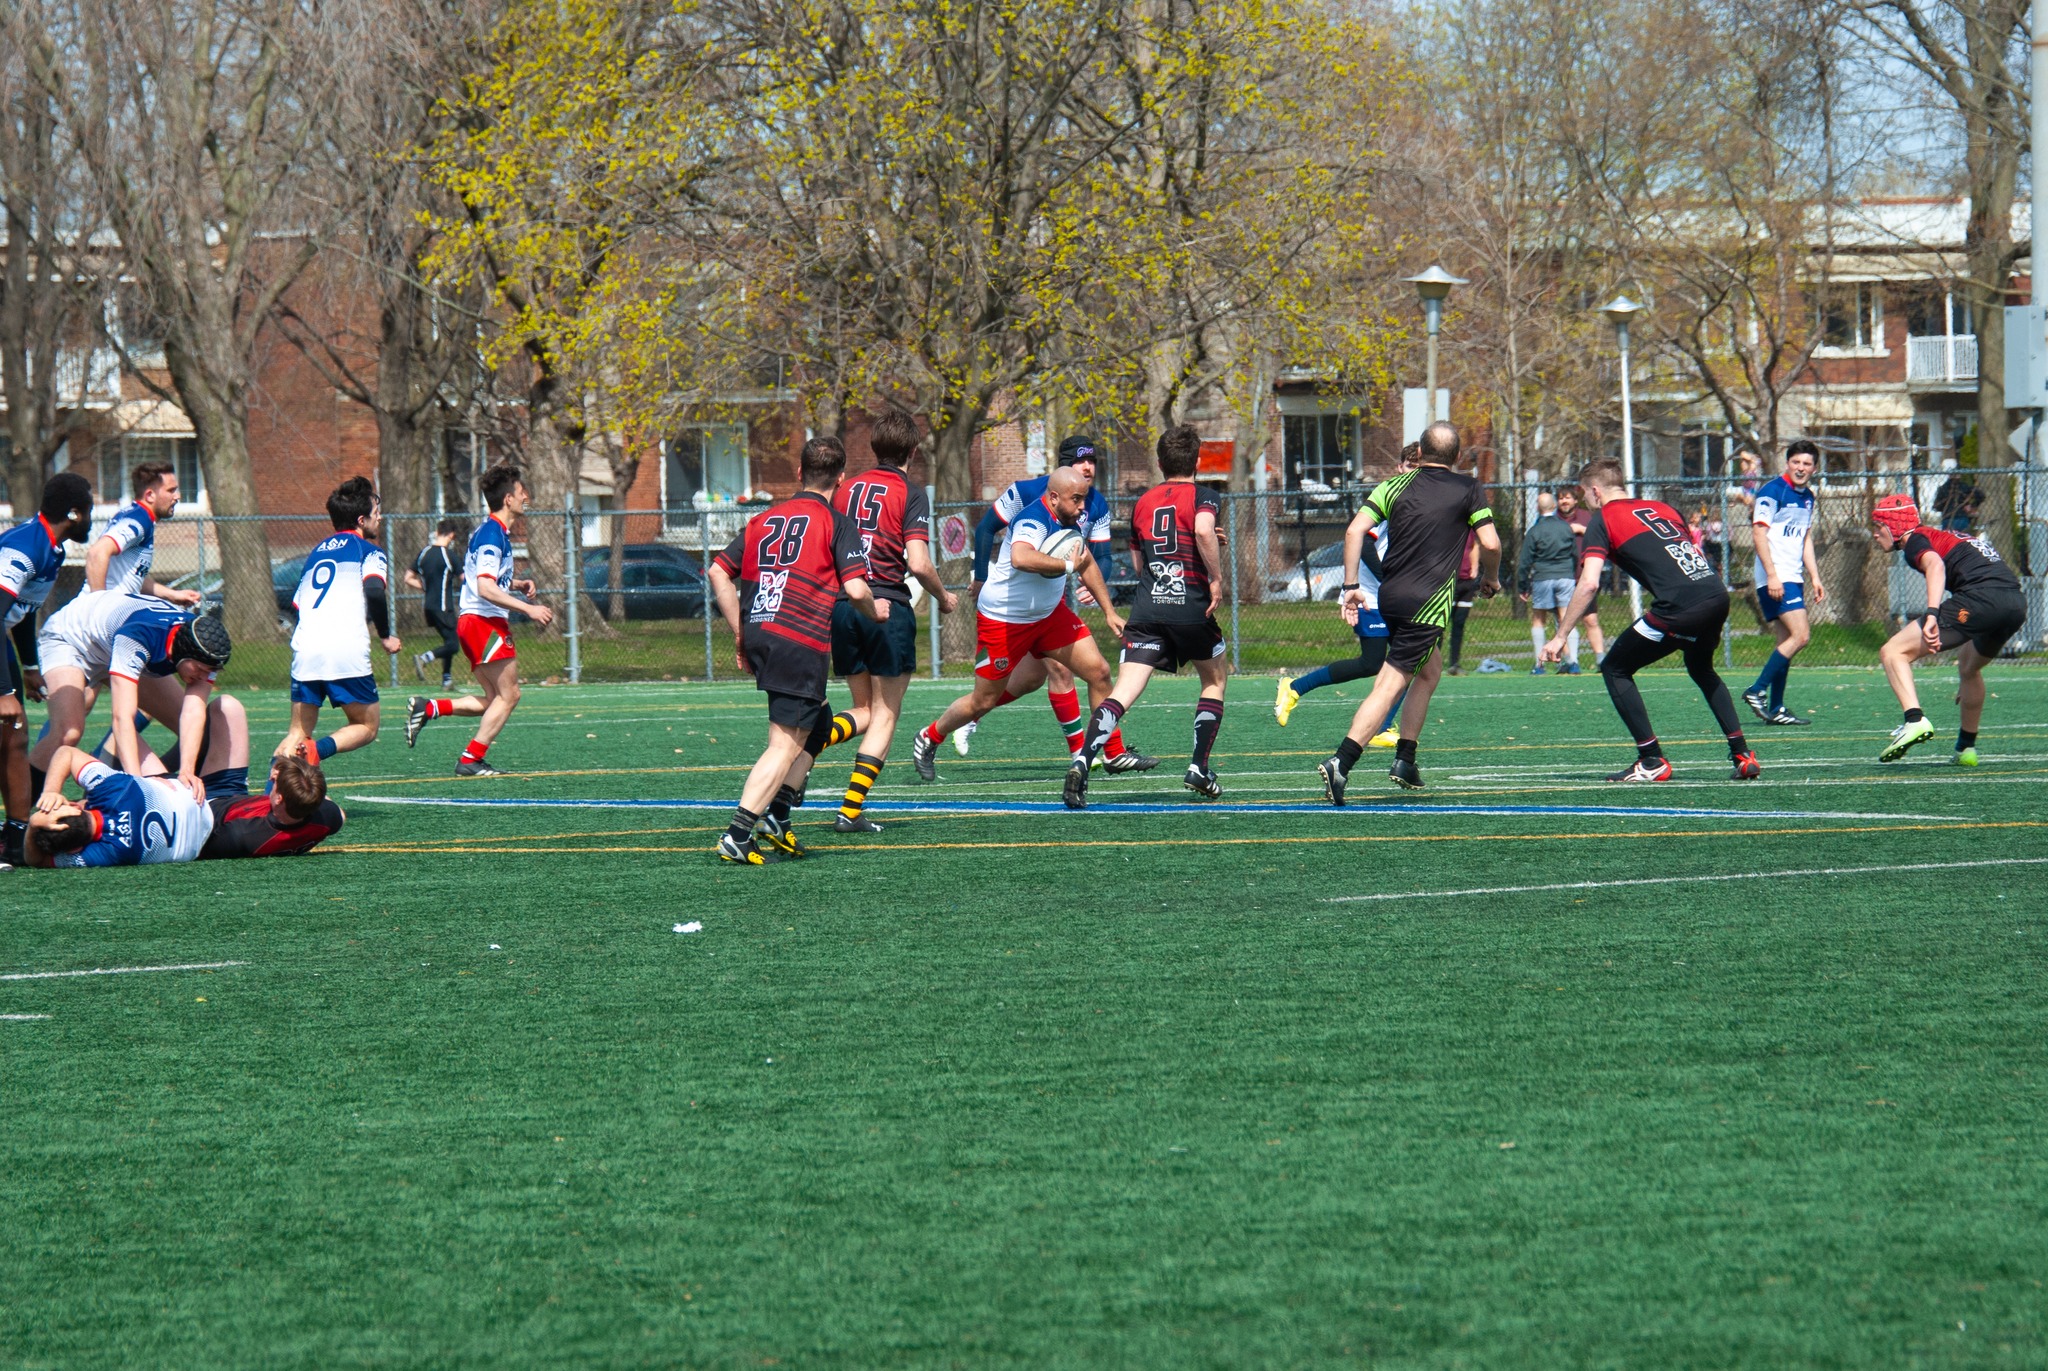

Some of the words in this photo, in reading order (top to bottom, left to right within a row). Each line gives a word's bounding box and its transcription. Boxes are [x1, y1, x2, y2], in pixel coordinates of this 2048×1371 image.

[846, 481, 888, 531] 15
[1152, 505, 1177, 555] 9
[1632, 508, 1681, 540] 6
[316, 537, 349, 552] ASN
[758, 515, 810, 567] 28
[312, 559, 337, 609] 9
[141, 809, 177, 852] 2
